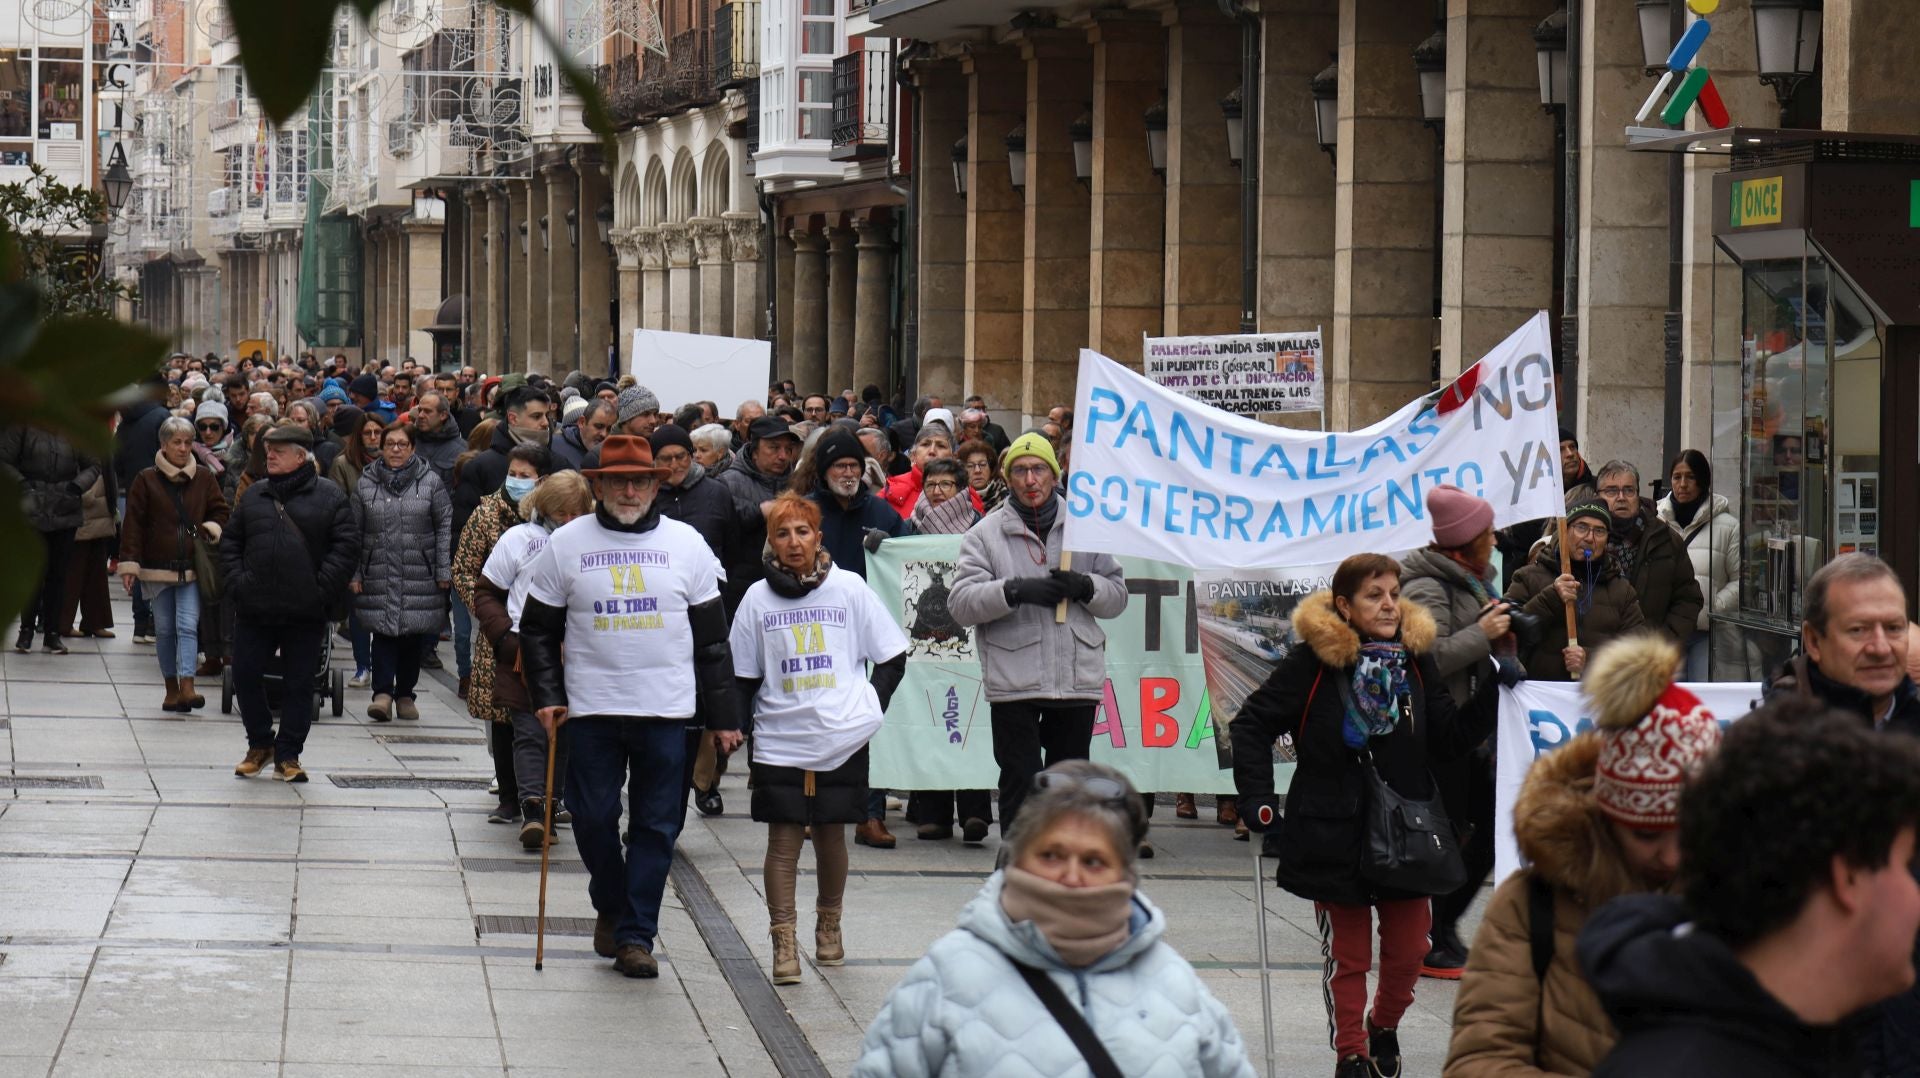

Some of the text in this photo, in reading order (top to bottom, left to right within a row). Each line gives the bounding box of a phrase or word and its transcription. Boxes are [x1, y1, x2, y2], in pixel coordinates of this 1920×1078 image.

[1745, 183, 1778, 218] ONCE
[1214, 340, 1252, 355] UNIDA
[1256, 338, 1276, 352] SIN
[1278, 338, 1320, 351] VALLAS
[1151, 359, 1164, 371] NI
[1167, 359, 1219, 371] PUENTES
[1193, 375, 1208, 386] DE
[1225, 388, 1239, 399] AL
[1241, 388, 1269, 399] TREN
[1272, 388, 1285, 398] DE
[1289, 387, 1311, 397] LAS
[1084, 352, 1552, 481] PANTALLAS NO
[1500, 439, 1554, 506] YA
[582, 551, 666, 568] SOTERRAMIENTO
[608, 564, 646, 595] YA
[1208, 578, 1312, 599] PANTALLAS
[594, 597, 657, 614] O EL TREN
[765, 608, 844, 628] SOTERRAMIENTO
[790, 622, 826, 655] YA
[781, 655, 832, 674] O EL TREN
